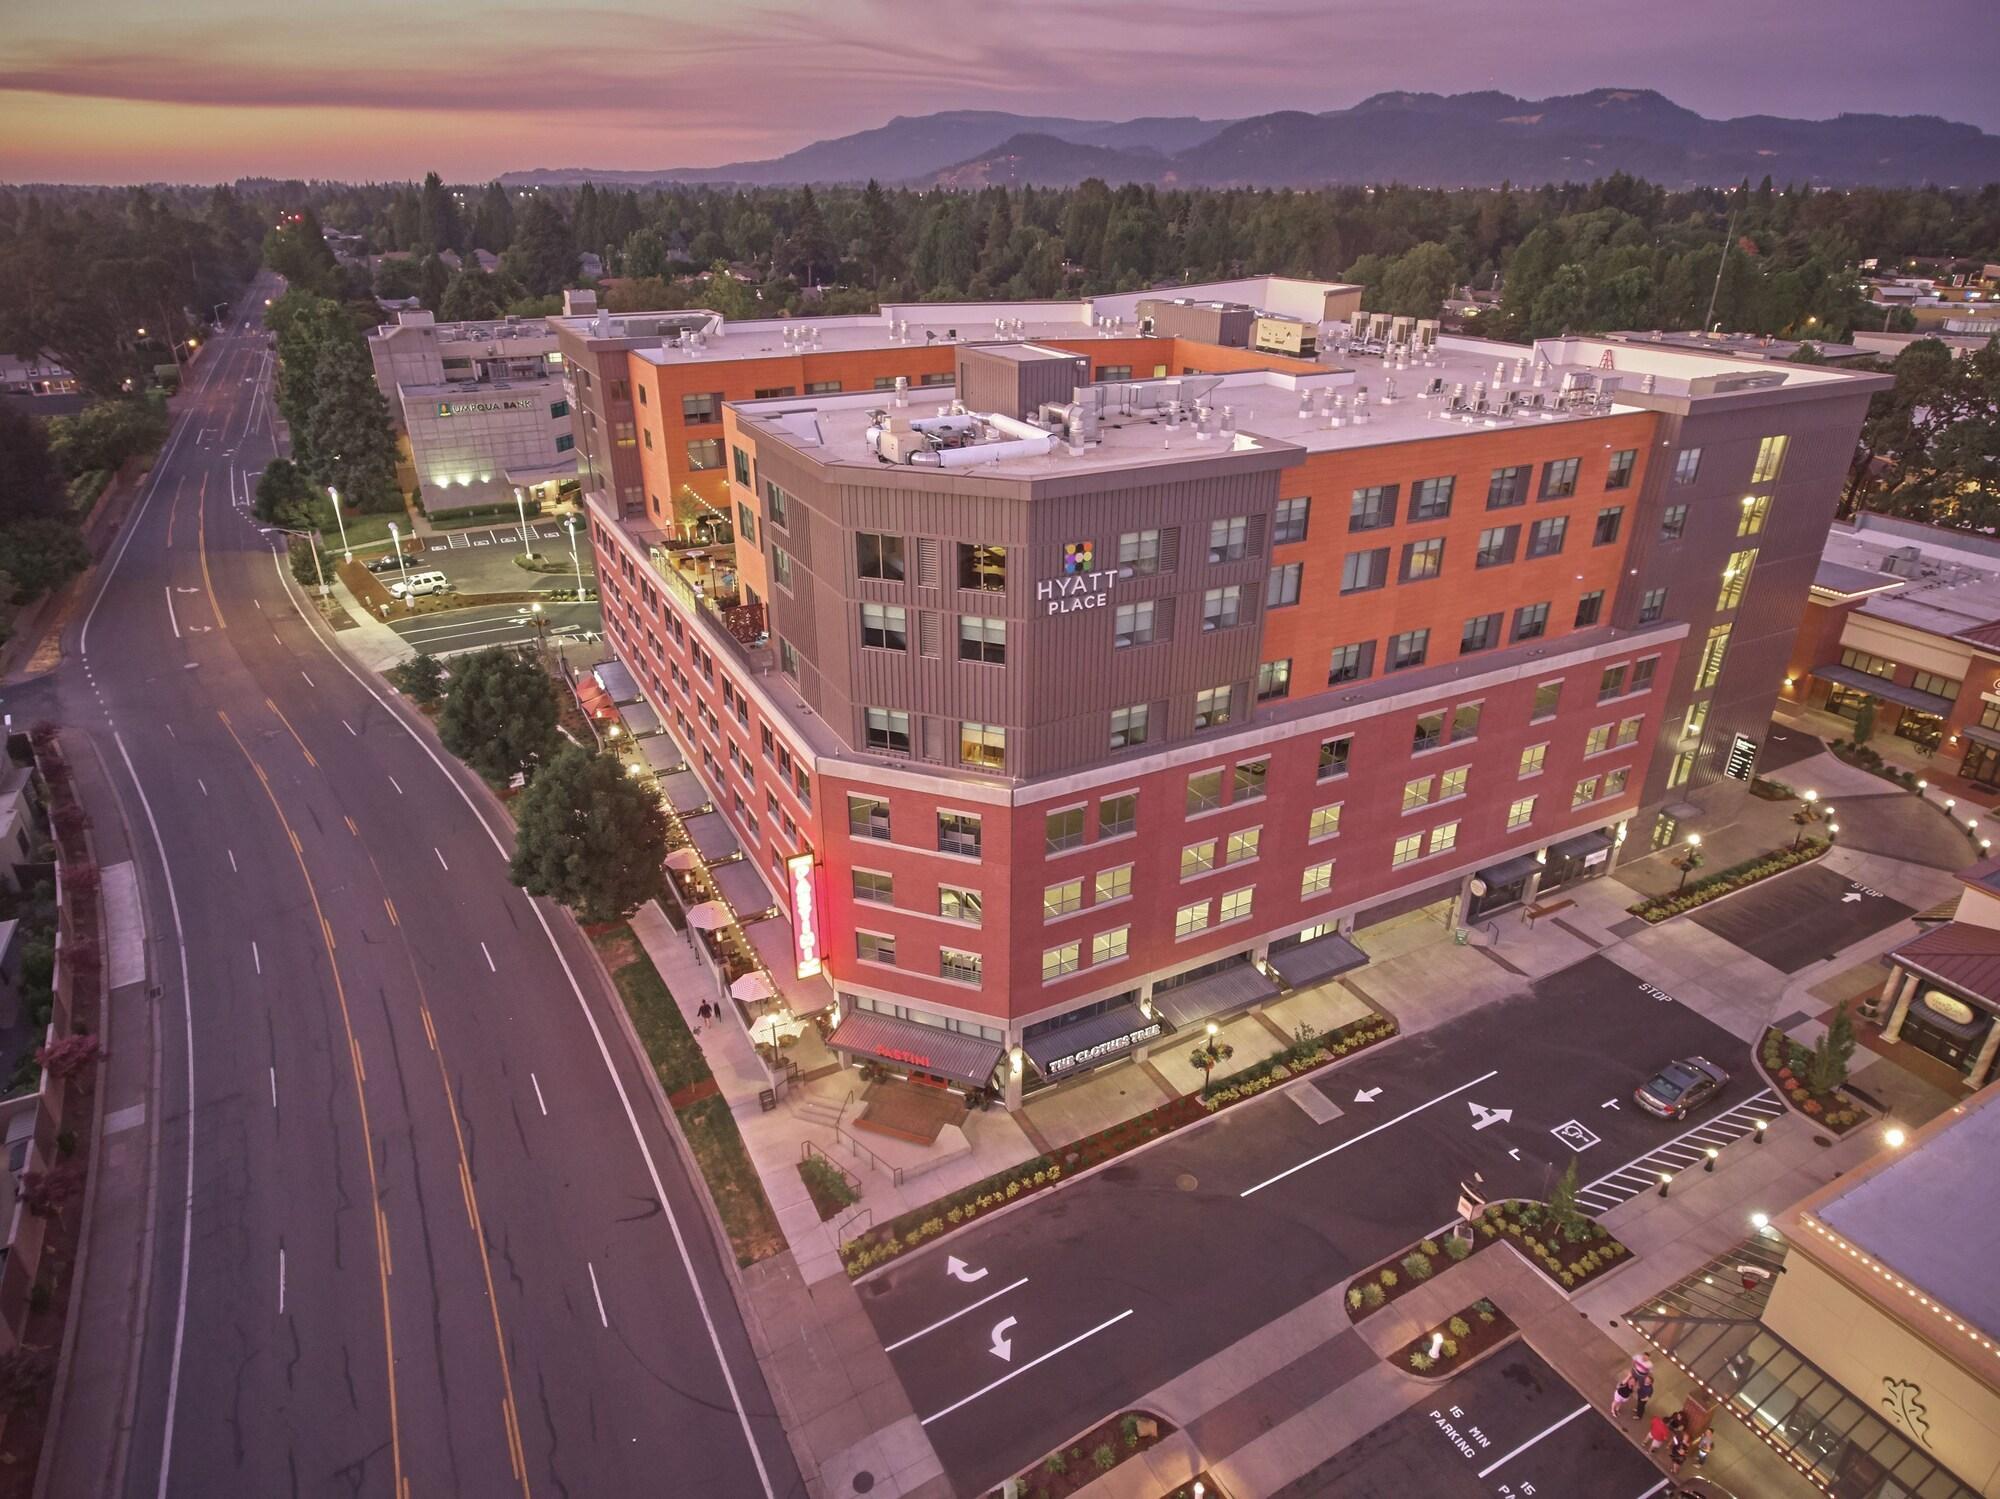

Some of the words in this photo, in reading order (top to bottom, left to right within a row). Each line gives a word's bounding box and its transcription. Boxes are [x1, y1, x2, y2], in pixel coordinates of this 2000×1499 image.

[452, 402, 500, 415] UMPQUA
[503, 400, 531, 411] BANK
[1037, 570, 1118, 601] HYATT
[1048, 593, 1107, 616] PLACE
[1851, 882, 1884, 898] STOP
[1638, 983, 1673, 1002] STOP
[875, 1044, 931, 1067] PASTINI
[1049, 1056, 1076, 1073] THE
[1075, 1035, 1131, 1062] CLOTHES
[1129, 1024, 1161, 1043] TREE
[1429, 1410, 1476, 1458] PARKING
[1449, 1405, 1465, 1419] 15
[1468, 1426, 1492, 1448] MIN
[1520, 1481, 1537, 1496] 15
